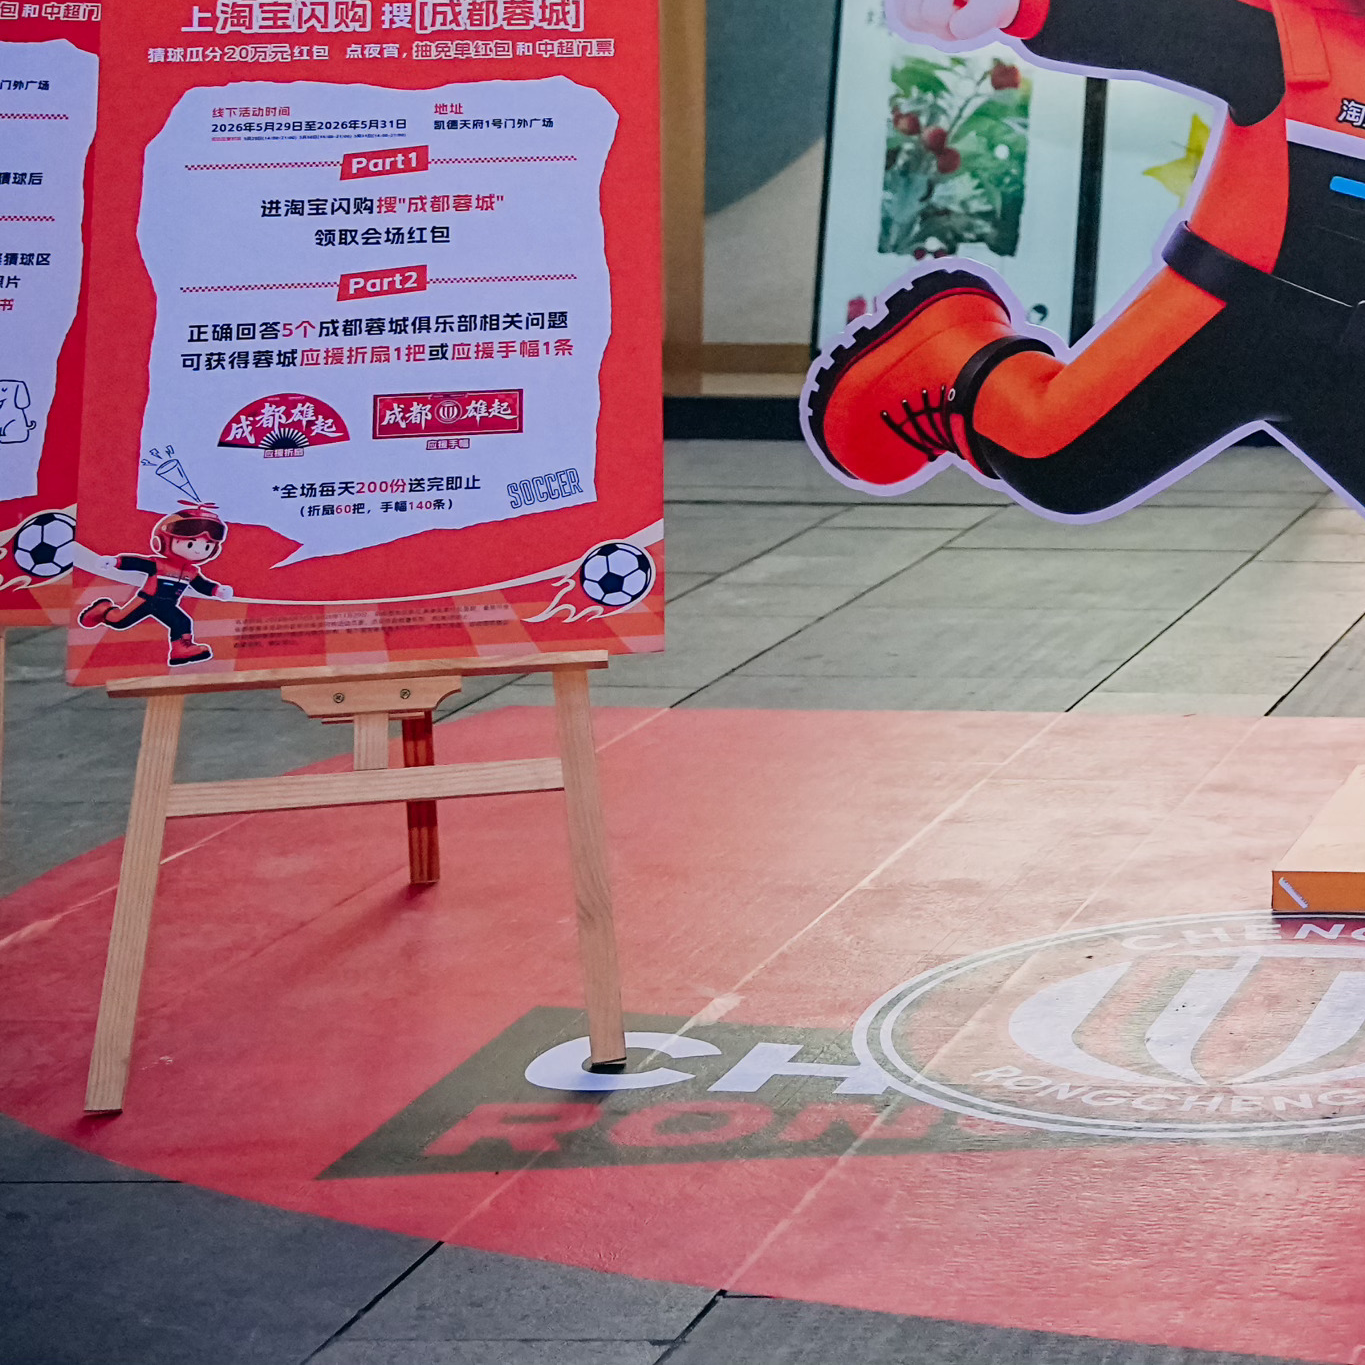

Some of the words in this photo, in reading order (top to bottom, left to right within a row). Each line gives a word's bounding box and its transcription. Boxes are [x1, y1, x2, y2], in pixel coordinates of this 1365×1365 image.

[147, 44, 330, 63] 猜球瓜分20万元红包
[212, 106, 291, 119] 线下活动时间
[434, 103, 464, 115] 地址
[211, 119, 407, 133] 2026年5月29日至2026年5月31日
[433, 117, 554, 131] 凯德天府1号门外广场
[314, 225, 452, 247] 领取会场红包
[0, 252, 51, 266] 猜球区
[348, 271, 418, 295] Part2
[187, 310, 569, 343] 正确回答5个成都蓉城俱乐部相关问题
[181, 338, 574, 371] 可获得蓉城应援折扇1把或应援手幅1条
[225, 401, 344, 444] 成都雄起
[381, 402, 432, 430] 成都
[461, 398, 518, 427] 雄起
[506, 468, 584, 510] SOCCER
